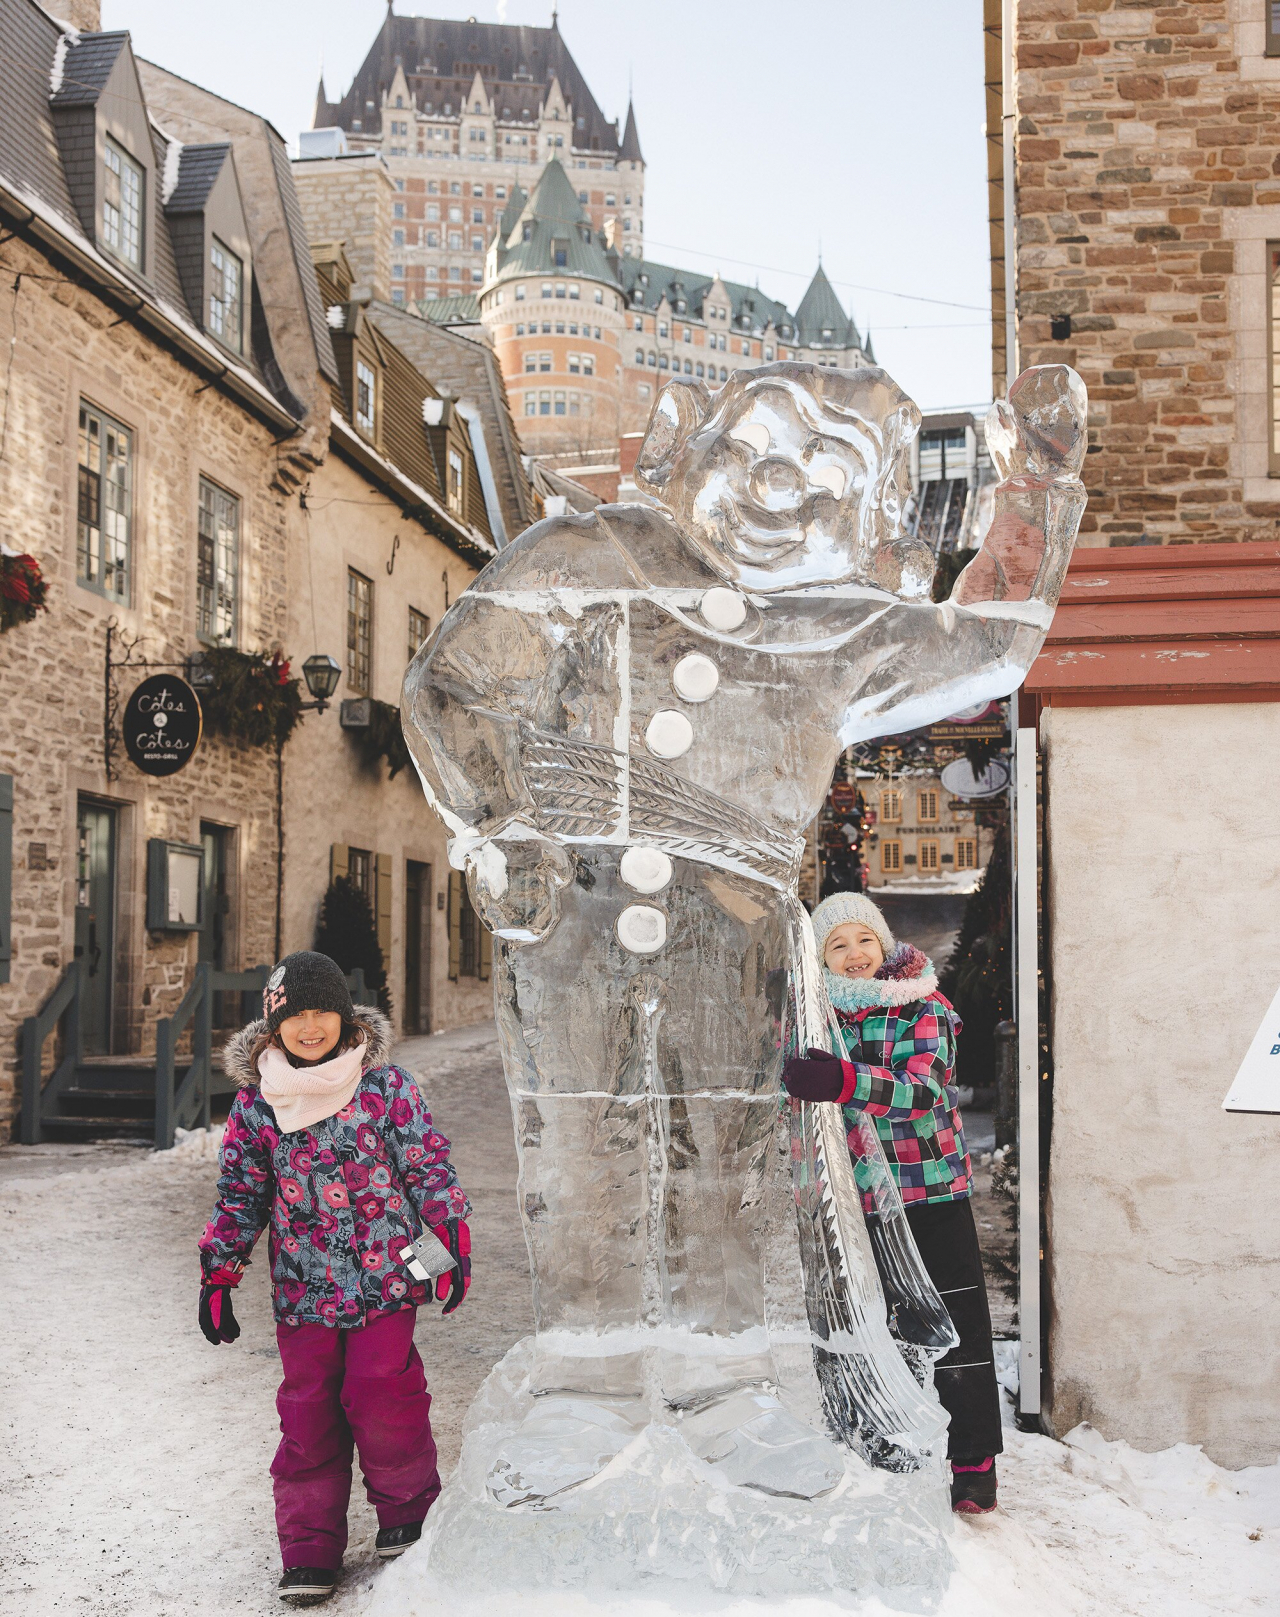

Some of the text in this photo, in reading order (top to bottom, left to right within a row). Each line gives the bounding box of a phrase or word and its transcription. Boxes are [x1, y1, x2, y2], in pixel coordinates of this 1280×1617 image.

[138, 688, 186, 713] Côtes
[136, 729, 190, 749] Côtes
[896, 826, 961, 835] FUNICULAIRE
